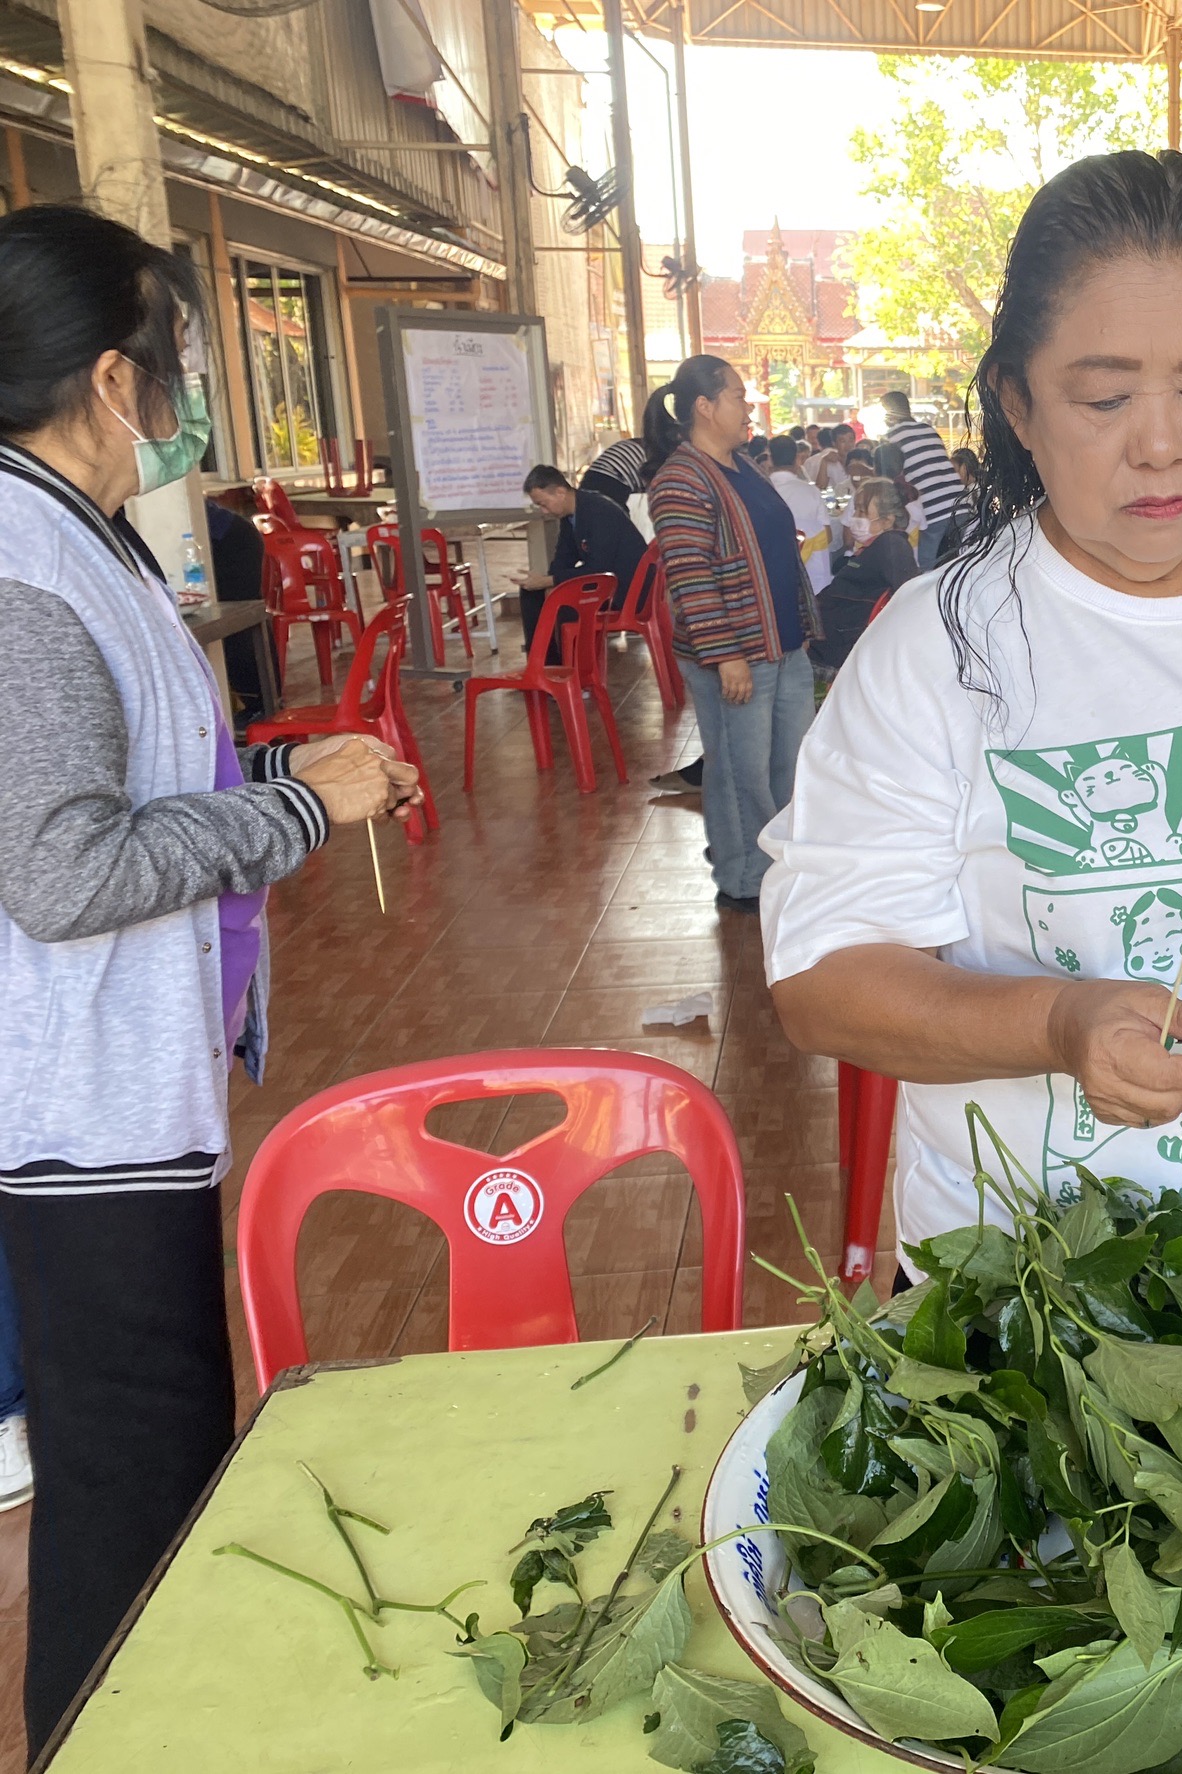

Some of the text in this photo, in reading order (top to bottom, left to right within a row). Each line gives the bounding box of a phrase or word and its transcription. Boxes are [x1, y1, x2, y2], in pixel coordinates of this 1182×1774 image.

[485, 1181, 520, 1197] Grade
[488, 1192, 523, 1229] A
[481, 1224, 531, 1241] High Quality
